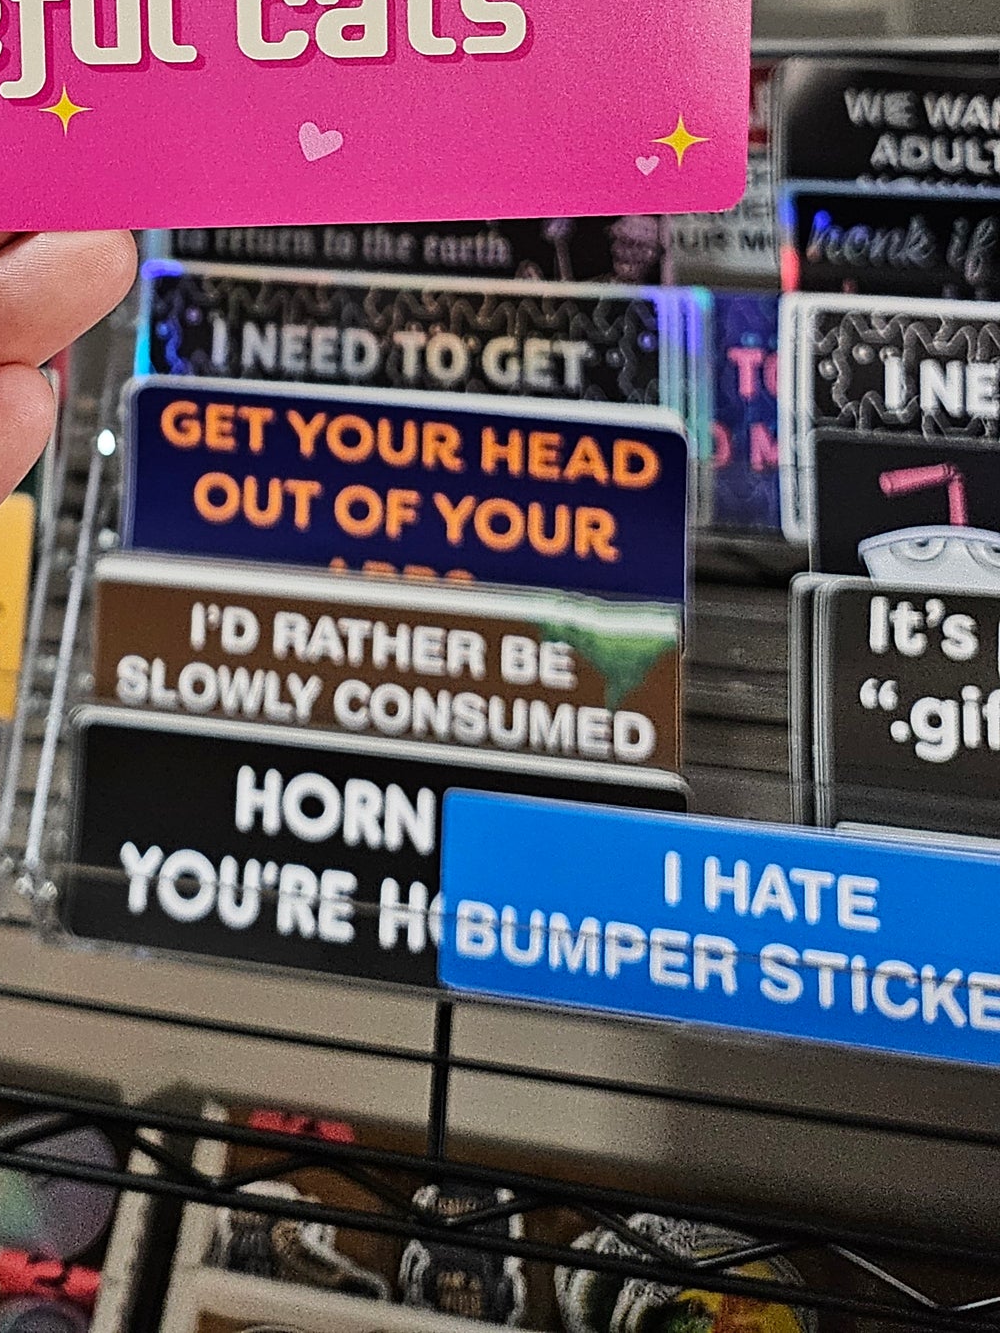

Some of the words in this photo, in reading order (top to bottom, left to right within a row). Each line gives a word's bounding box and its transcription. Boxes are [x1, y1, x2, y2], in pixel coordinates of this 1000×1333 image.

[844, 89, 918, 127] WE
[323, 228, 355, 262] to
[362, 226, 417, 263] the
[210, 314, 228, 370] I
[242, 320, 381, 379] NEED
[393, 329, 469, 387] TO
[482, 335, 592, 392] GET
[884, 356, 904, 414] I
[160, 400, 274, 454] GET
[286, 409, 465, 473] YOUR
[481, 425, 662, 488] HEAD
[193, 471, 323, 531] OUT
[334, 483, 421, 540] OF
[433, 492, 621, 563] YOUR
[190, 601, 260, 656] I'D
[272, 610, 488, 681] RATHER
[501, 634, 579, 690] BE
[868, 595, 980, 662] It's
[116, 654, 323, 724] SLOWLY
[333, 678, 656, 763] CONSUMED
[235, 764, 437, 856] HORN
[120, 840, 358, 944] YOU'RE
[664, 850, 683, 907] I
[703, 855, 881, 933] HATE
[455, 899, 738, 996] BUMPER
